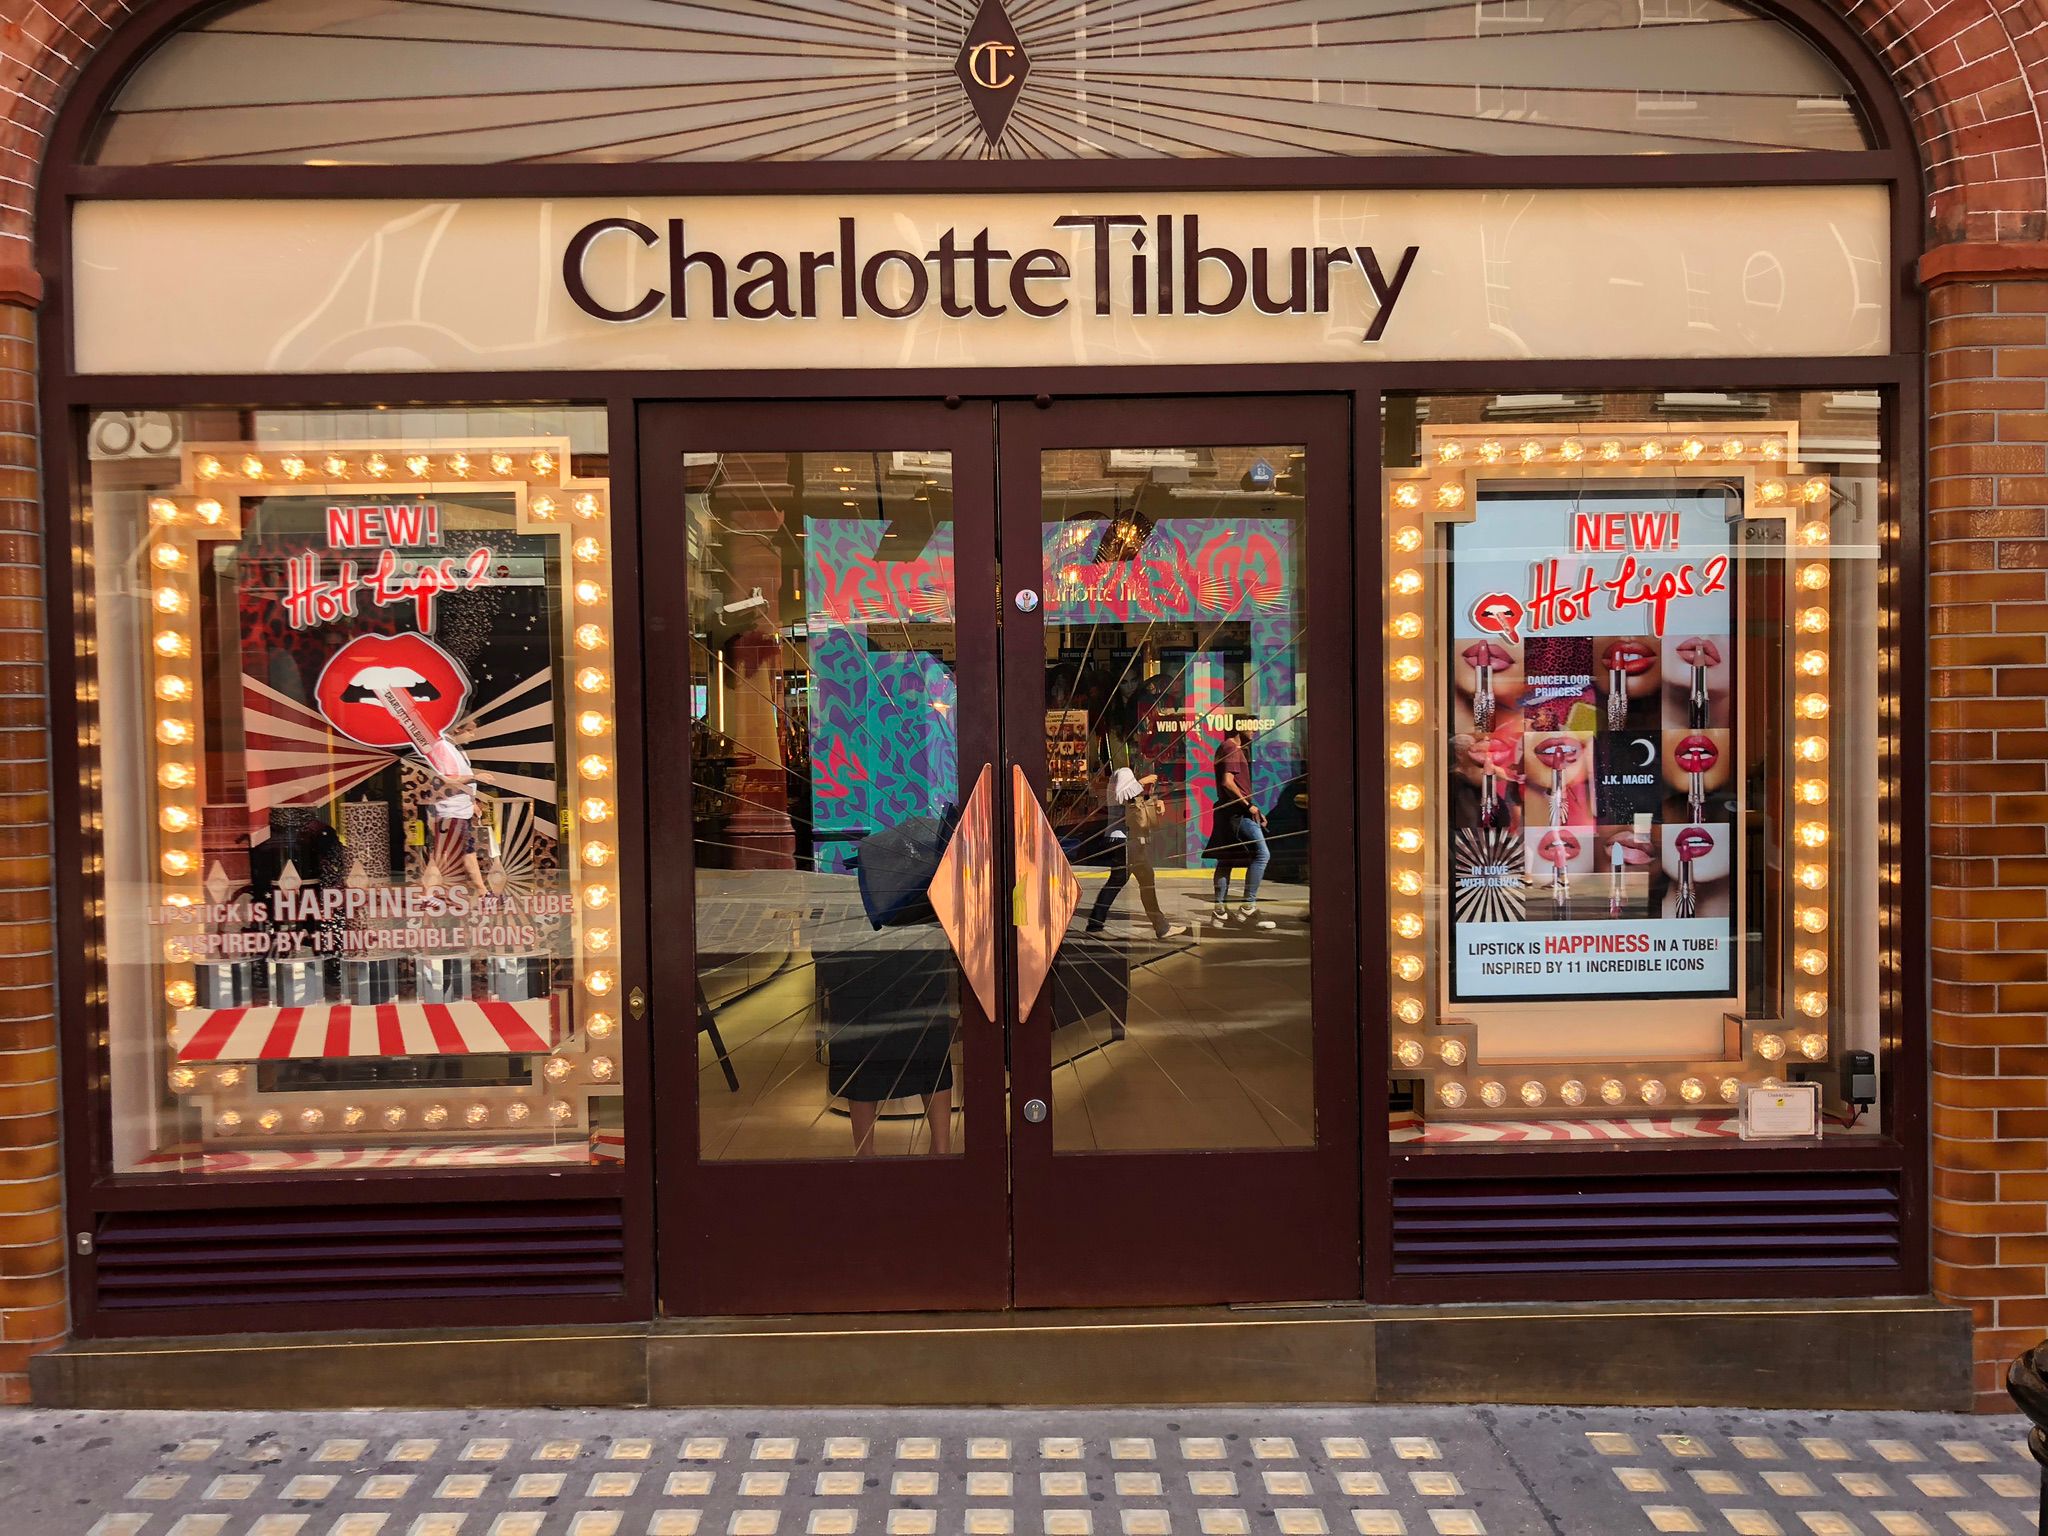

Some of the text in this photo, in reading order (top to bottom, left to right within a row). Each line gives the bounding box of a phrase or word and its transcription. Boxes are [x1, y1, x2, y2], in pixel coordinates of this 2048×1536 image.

[327, 505, 439, 548] NEW!
[1574, 512, 1681, 553] NEW!
[282, 547, 491, 634] Hot Lips 2
[1527, 554, 1729, 638] Hot Lips 2
[1527, 674, 1591, 686] DANCEFLOOR
[1535, 686, 1584, 698] PRINCESS
[384, 691, 430, 747] CHARLOTTE TILBURY
[1156, 721, 1178, 733] WHO
[1205, 713, 1234, 732] YOU
[1601, 774, 1655, 785] J.K. MAGIC
[1471, 865, 1510, 876] IN LOVE
[1460, 878, 1485, 888] WITH
[147, 903, 242, 925] LIPSTICK
[247, 902, 268, 923] IS
[272, 885, 470, 922] HAPPINESS
[502, 897, 518, 915] A
[519, 894, 575, 915] TUBE
[173, 924, 537, 956] INSPIRED BY 11 INCREDIBLE ICONS
[1468, 934, 1718, 955] LIPSTICK IS HAPPINESS IN A TUBE!
[1482, 958, 1705, 975] INSPIRED BY 11 INCREDIBLE ICONS
